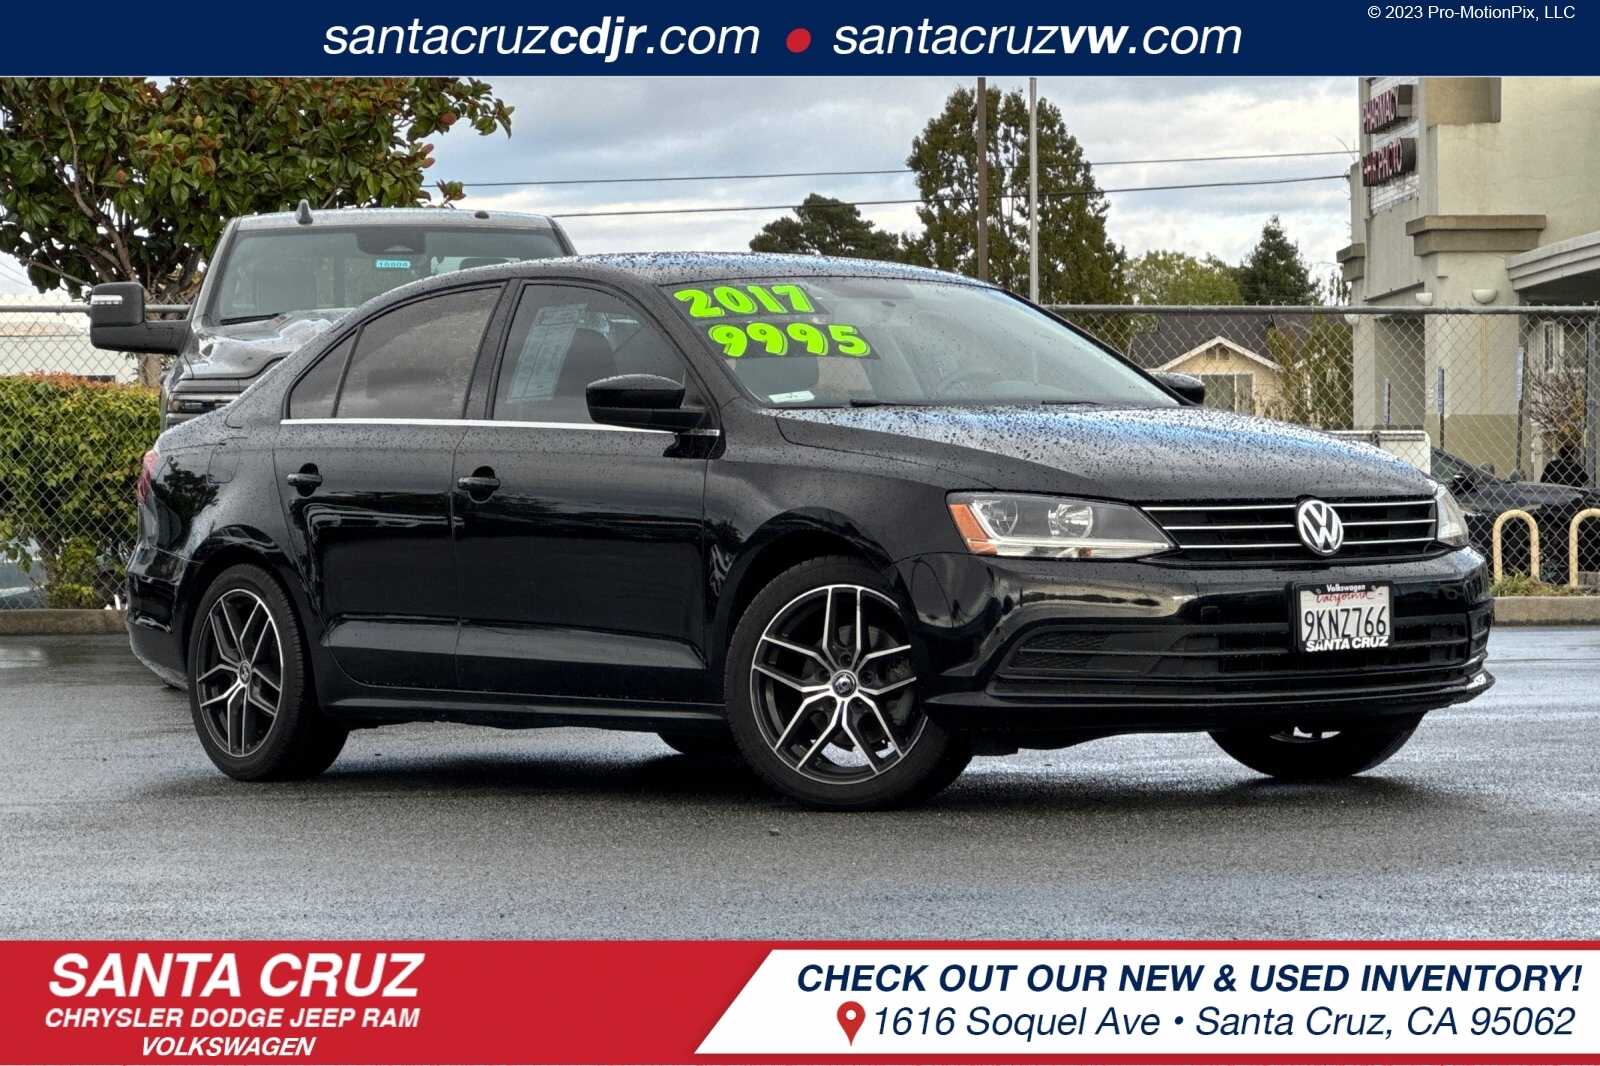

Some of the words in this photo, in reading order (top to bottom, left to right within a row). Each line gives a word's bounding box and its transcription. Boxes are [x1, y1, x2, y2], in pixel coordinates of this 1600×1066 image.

[1361, 86, 1399, 133] PHARMACY
[673, 285, 816, 318] 2017
[708, 321, 870, 358] 9995
[1326, 583, 1366, 593] Volkswagen
[1304, 606, 1387, 641] 9KNZ766
[1305, 637, 1351, 652] SANTA
[1352, 635, 1389, 648] CRUZ
